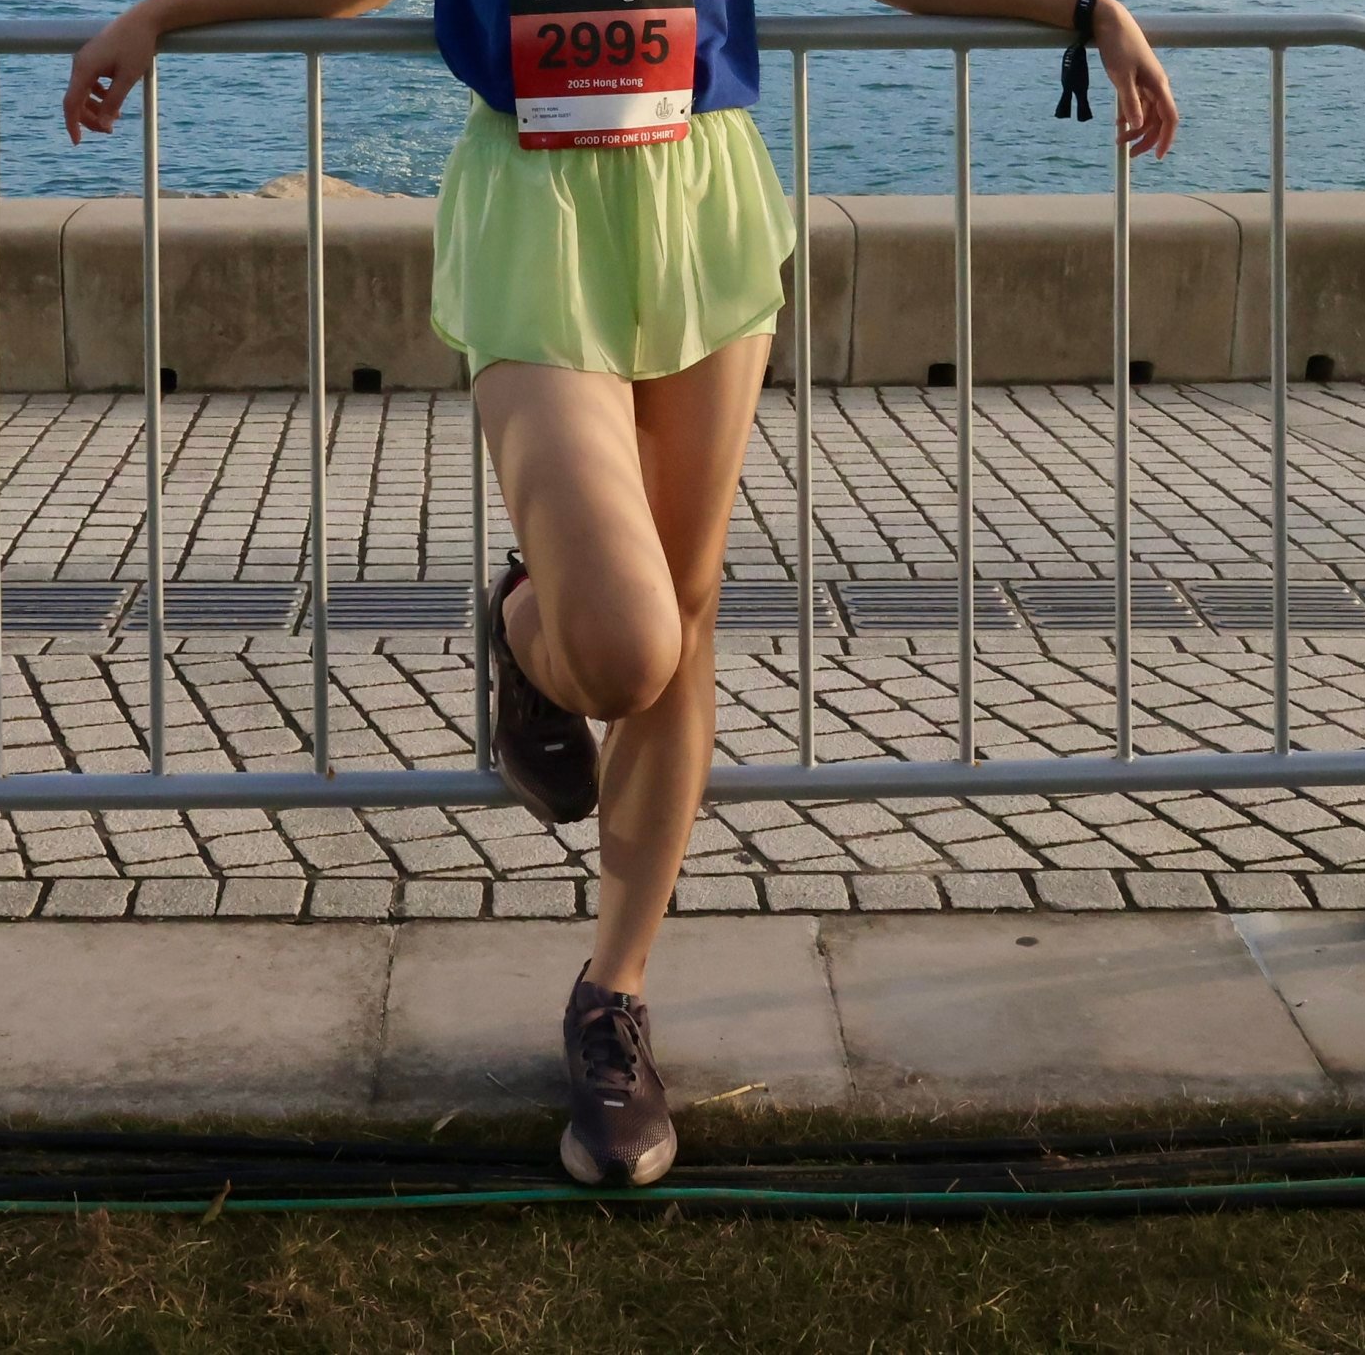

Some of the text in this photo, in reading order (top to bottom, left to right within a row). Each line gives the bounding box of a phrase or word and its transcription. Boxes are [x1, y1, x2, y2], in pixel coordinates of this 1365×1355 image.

[537, 19, 670, 70] 2995
[567, 77, 644, 89] 2025 Hong Kong
[574, 129, 675, 146] GOOD FOR ONE (1) SHIRT
